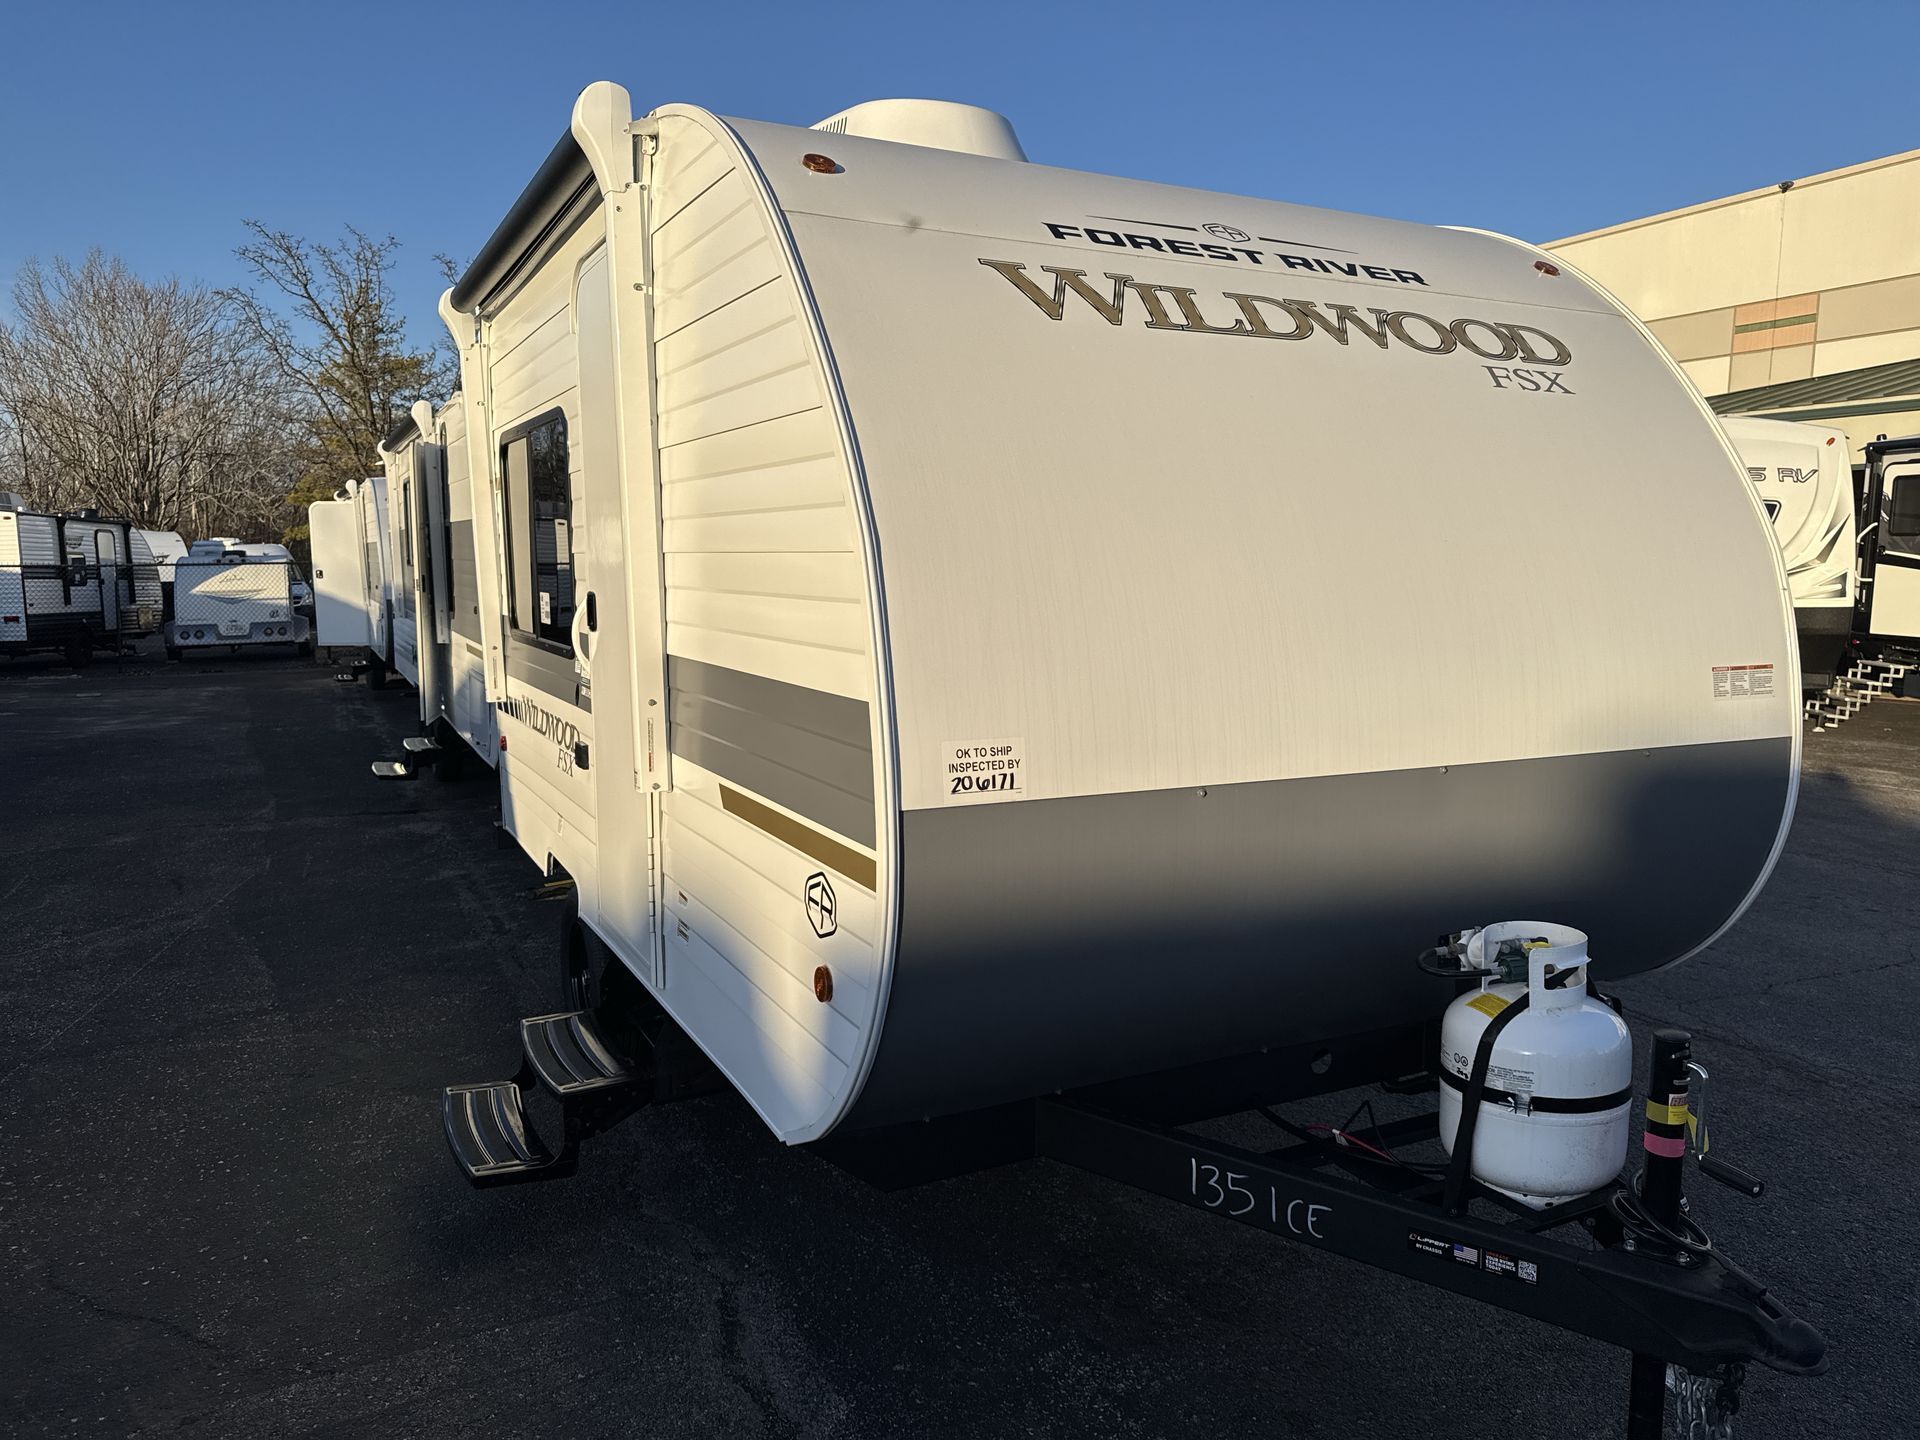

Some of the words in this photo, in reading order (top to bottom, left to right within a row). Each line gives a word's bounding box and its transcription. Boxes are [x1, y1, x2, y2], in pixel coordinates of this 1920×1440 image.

[1042, 222, 1264, 264] FOREST
[1274, 253, 1430, 287] RIVER
[978, 258, 1573, 366] WILDWOOD
[1481, 364, 1576, 395] FSX
[1777, 467, 1819, 483] RV
[522, 694, 581, 754] WILDWOOD
[557, 747, 575, 777] FSX
[948, 760, 1005, 773] INSPECTED
[1007, 758, 1021, 769] BY
[956, 748, 971, 759] OK
[973, 747, 987, 758] TO
[989, 745, 1012, 757] SHIP
